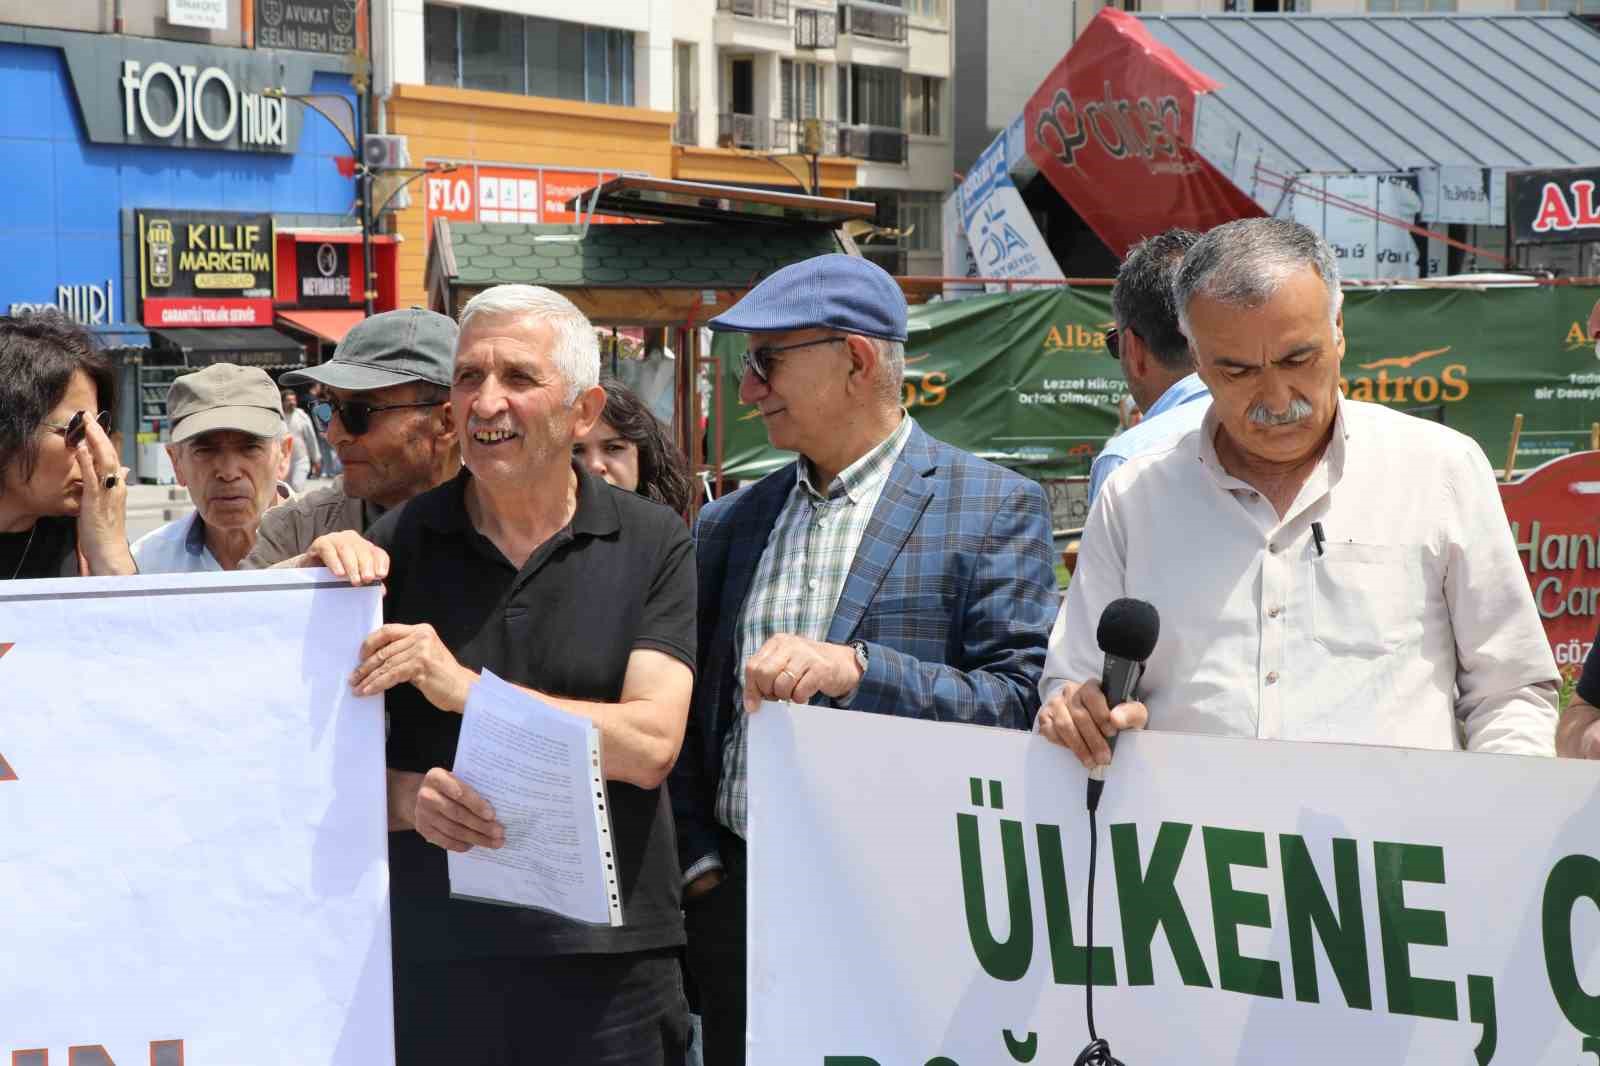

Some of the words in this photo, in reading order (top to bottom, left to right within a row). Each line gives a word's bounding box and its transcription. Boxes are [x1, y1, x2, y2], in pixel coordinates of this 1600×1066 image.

[286, 5, 329, 24] AVUKAT
[122, 60, 238, 142] FOTO
[428, 178, 471, 212] FLO
[187, 224, 261, 250] KILIF
[179, 249, 271, 272] MARKETİM
[1043, 378, 1084, 390] Lezzet
[1535, 386, 1554, 399] Bir
[1019, 391, 1056, 404] Ortak
[1511, 520, 1600, 573] Han
